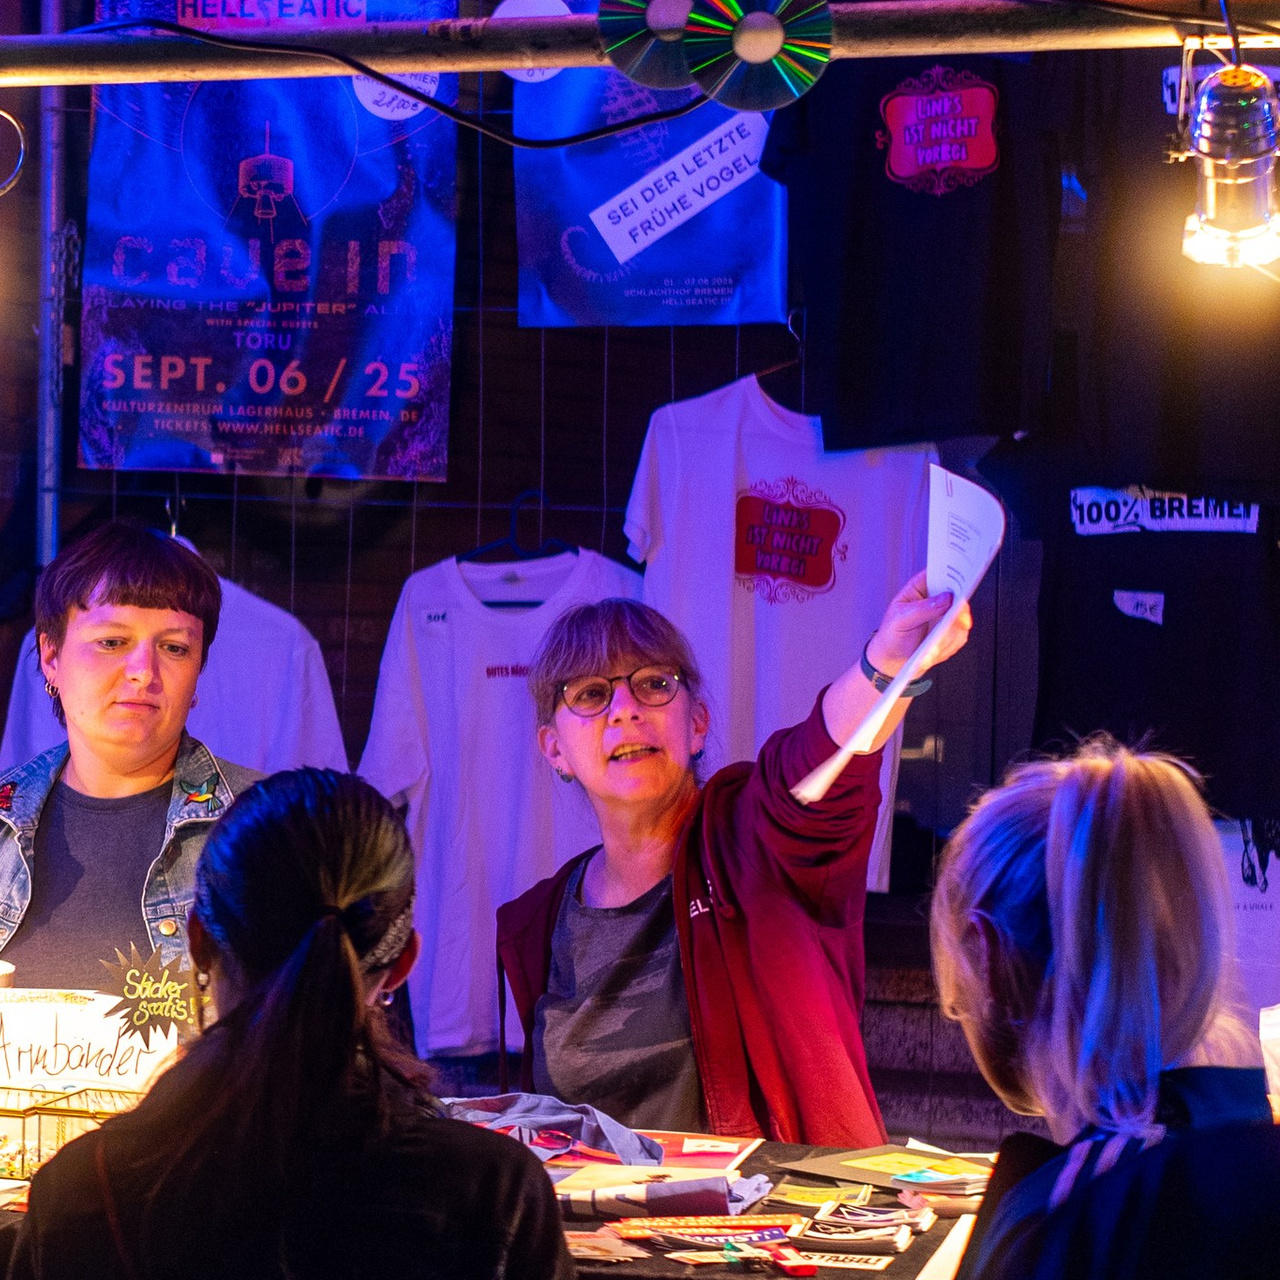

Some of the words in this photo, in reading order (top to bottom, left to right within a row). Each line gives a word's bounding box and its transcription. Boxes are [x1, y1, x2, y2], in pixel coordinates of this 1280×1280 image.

[904, 123, 925, 146] IST
[930, 116, 979, 140] NICHT
[607, 197, 639, 226] SEI
[641, 169, 680, 204] DER
[681, 122, 752, 175] LETZTE
[628, 193, 693, 245] FRÜHE
[692, 152, 759, 199] VOGEL
[92, 297, 187, 312] PLAYING
[196, 300, 240, 313] THE
[693, 287, 734, 296] BREMEN
[233, 330, 292, 351] TORU
[102, 354, 227, 395] SEPT.
[248, 357, 308, 396] 06
[363, 360, 420, 399] 25
[102, 400, 224, 416] KULTURZENTRUM
[228, 405, 314, 420] LAGERHAUS
[217, 421, 366, 438] WWW.HELLSEATIC.DE
[1076, 497, 1140, 526] 100%
[746, 524, 770, 545] IST
[771, 530, 824, 557] NICHT
[123, 968, 189, 1000] Sticker
